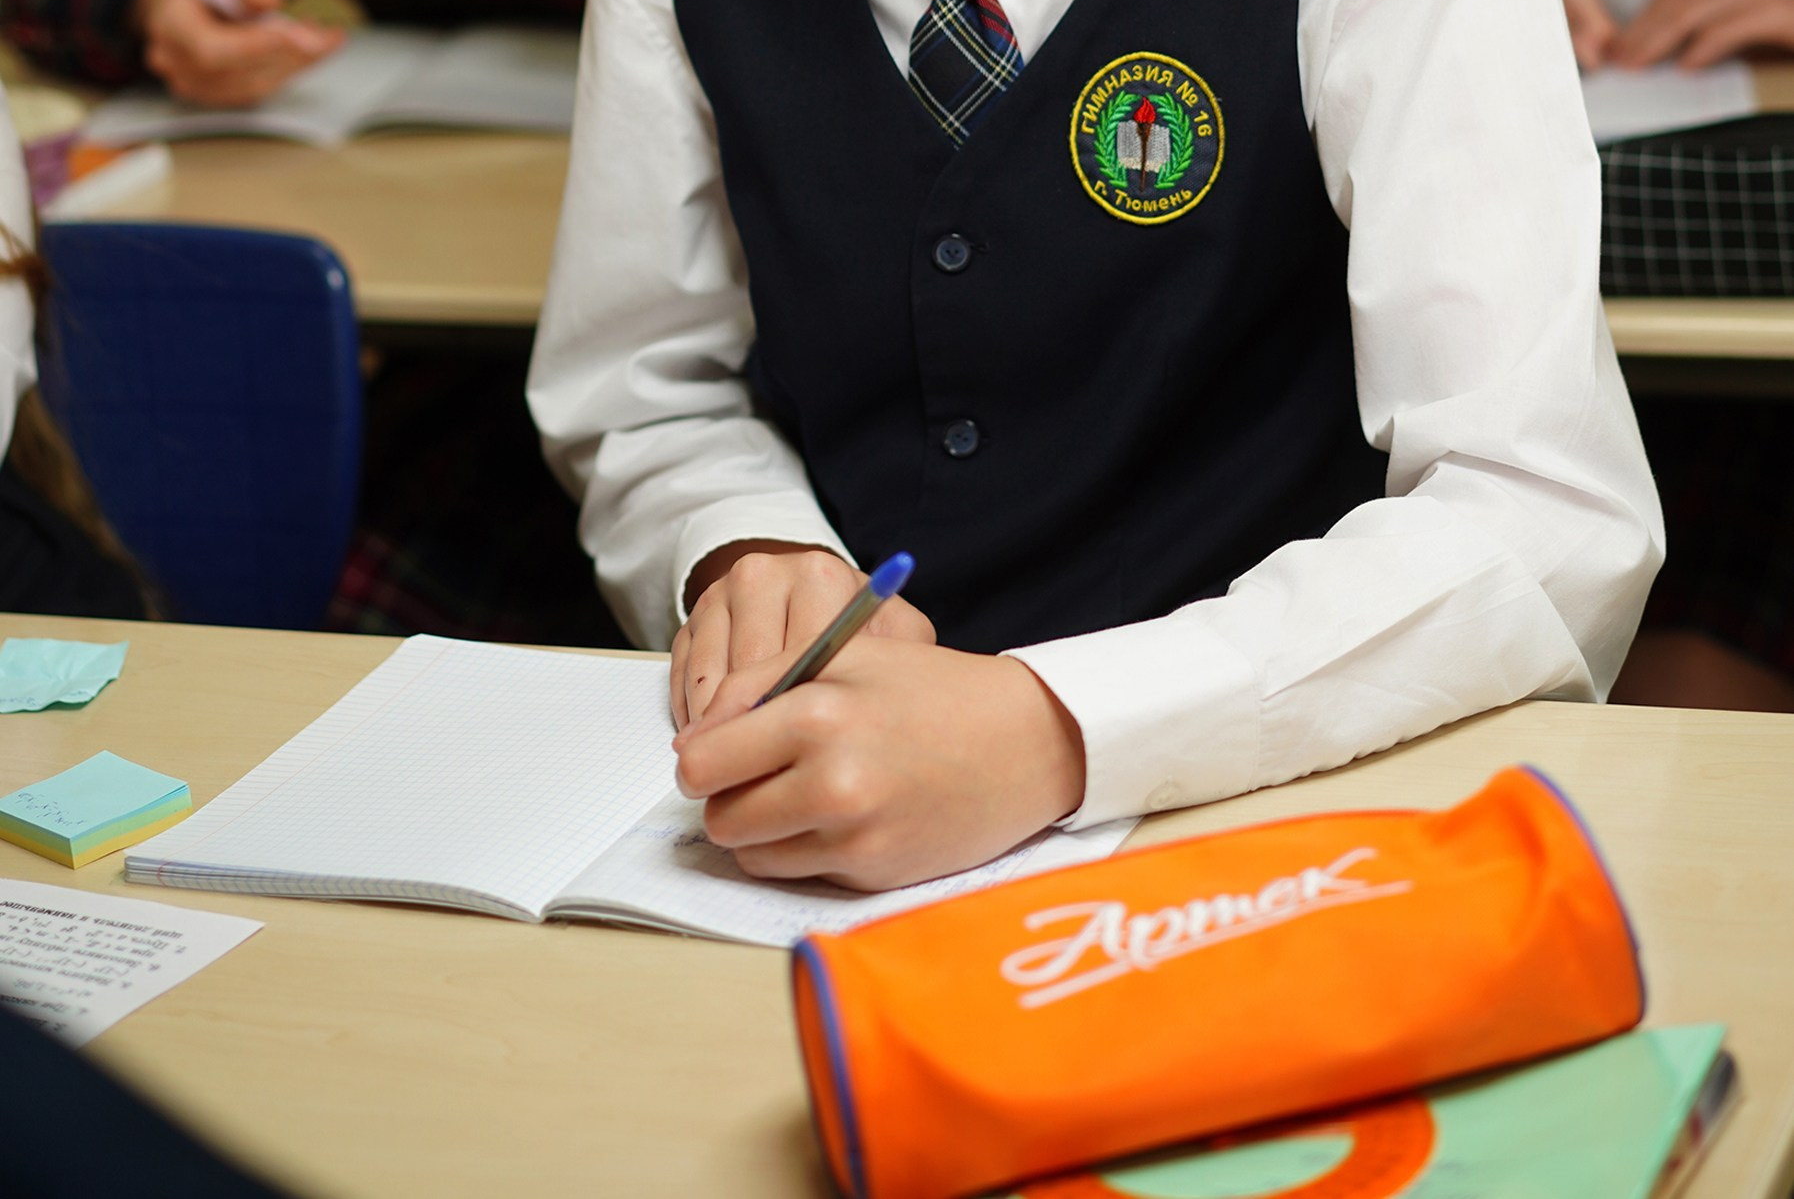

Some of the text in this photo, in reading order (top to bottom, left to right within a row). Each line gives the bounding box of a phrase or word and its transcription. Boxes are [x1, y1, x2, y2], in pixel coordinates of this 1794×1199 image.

[1081, 64, 1213, 138] ГИМНАЗИЯ № 16
[1114, 188, 1193, 212] Тюмень
[1000, 846, 1390, 989] Артек
